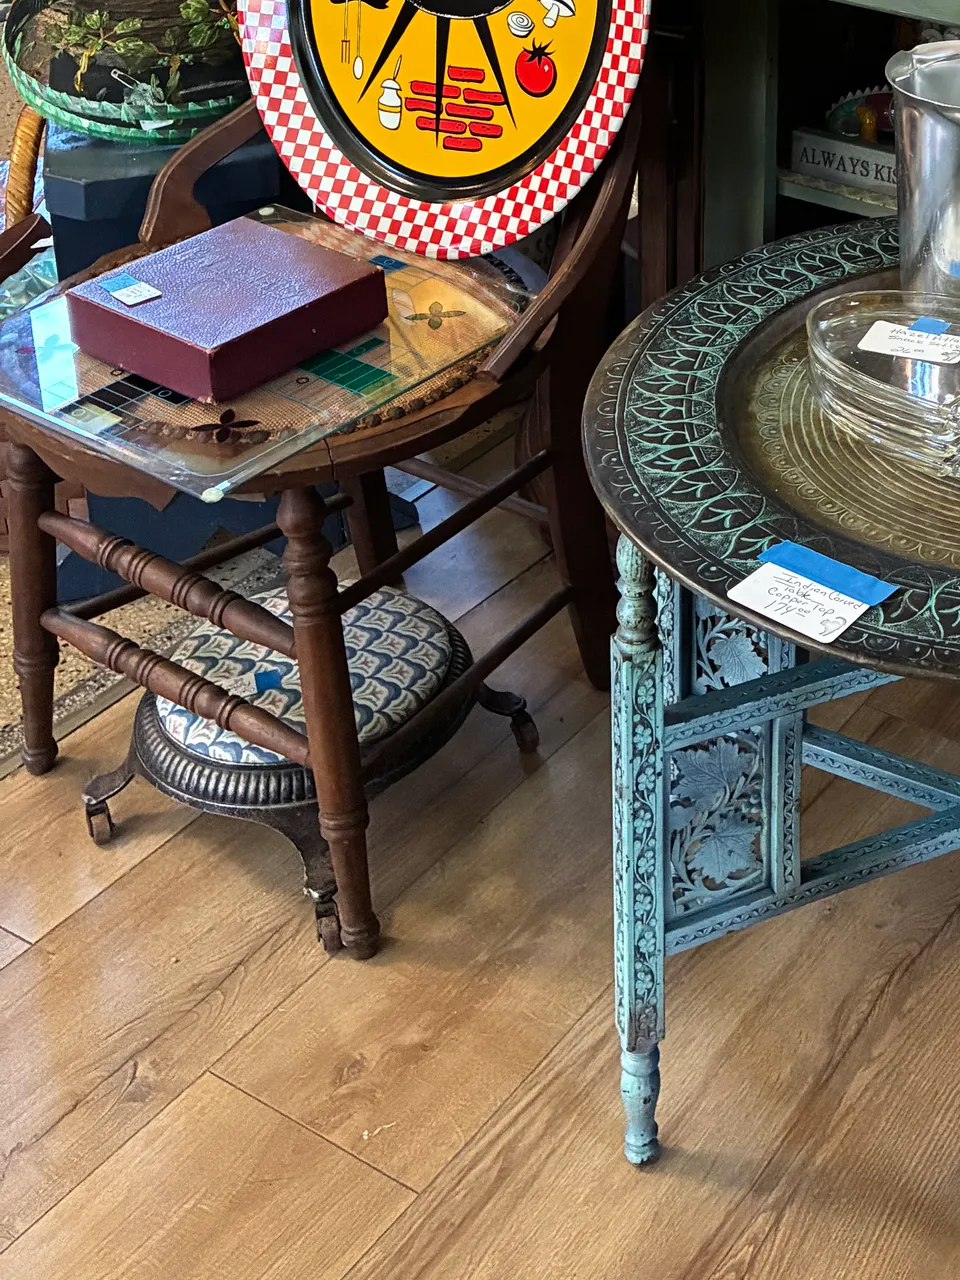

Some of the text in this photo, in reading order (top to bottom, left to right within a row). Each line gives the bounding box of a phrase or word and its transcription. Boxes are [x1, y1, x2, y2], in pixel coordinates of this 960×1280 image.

[799, 146, 870, 178] ALWAYS
[773, 572, 827, 597] Indian
[767, 587, 810, 610] Copper
